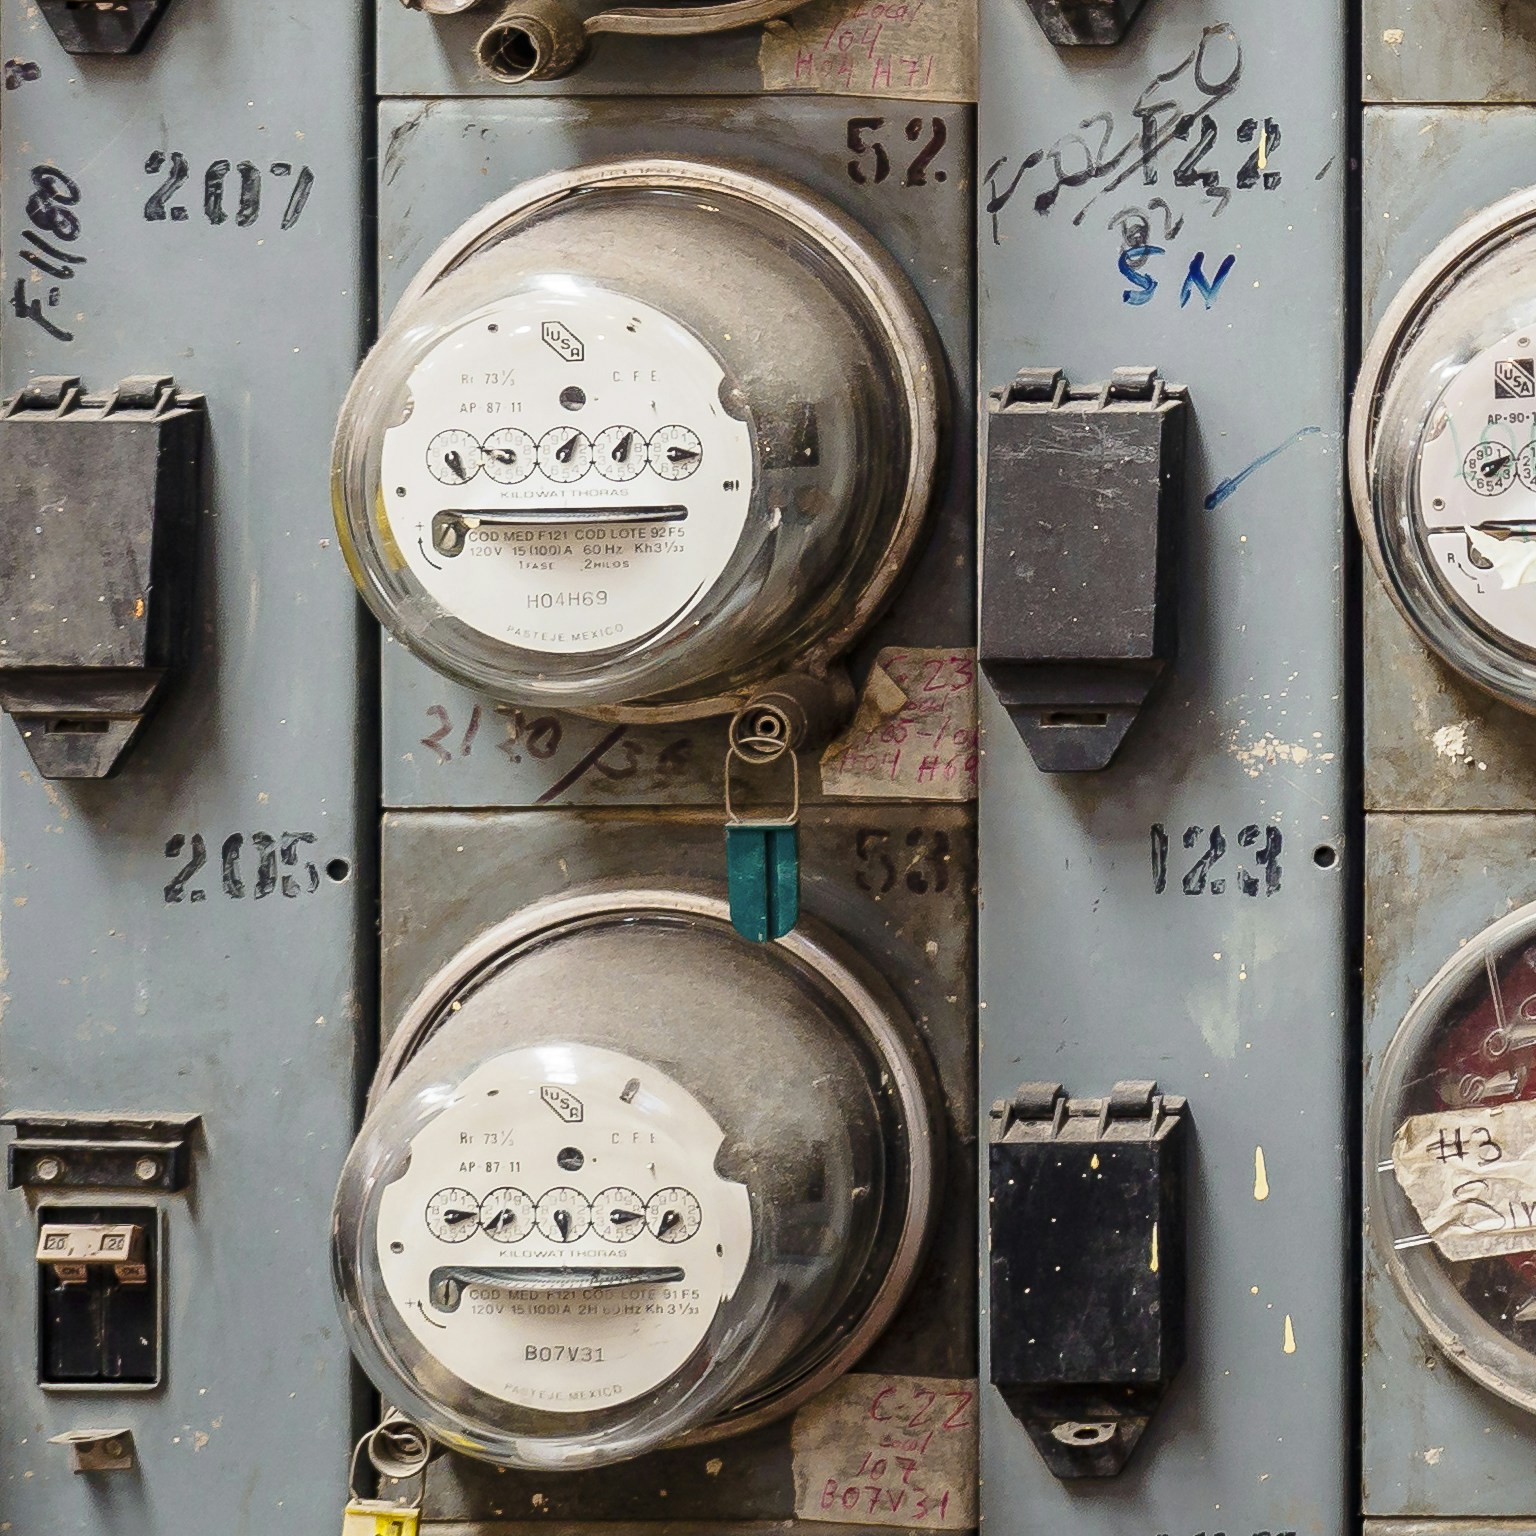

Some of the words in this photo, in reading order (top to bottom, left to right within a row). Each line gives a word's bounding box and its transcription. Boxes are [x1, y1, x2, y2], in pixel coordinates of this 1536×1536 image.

[846, 115, 948, 187] 52
[144, 150, 315, 230] 207
[546, 326, 580, 359] IUSA
[1498, 364, 1532, 395] IUSA
[500, 488, 629, 499] KILOWATTHORAS
[526, 590, 608, 609] H04H69
[855, 827, 951, 894] 53
[1148, 821, 1284, 899] 123
[544, 1088, 580, 1119] IUSA
[499, 1249, 628, 1258] KILOWATTHORAS
[525, 1346, 605, 1363] B07V31
